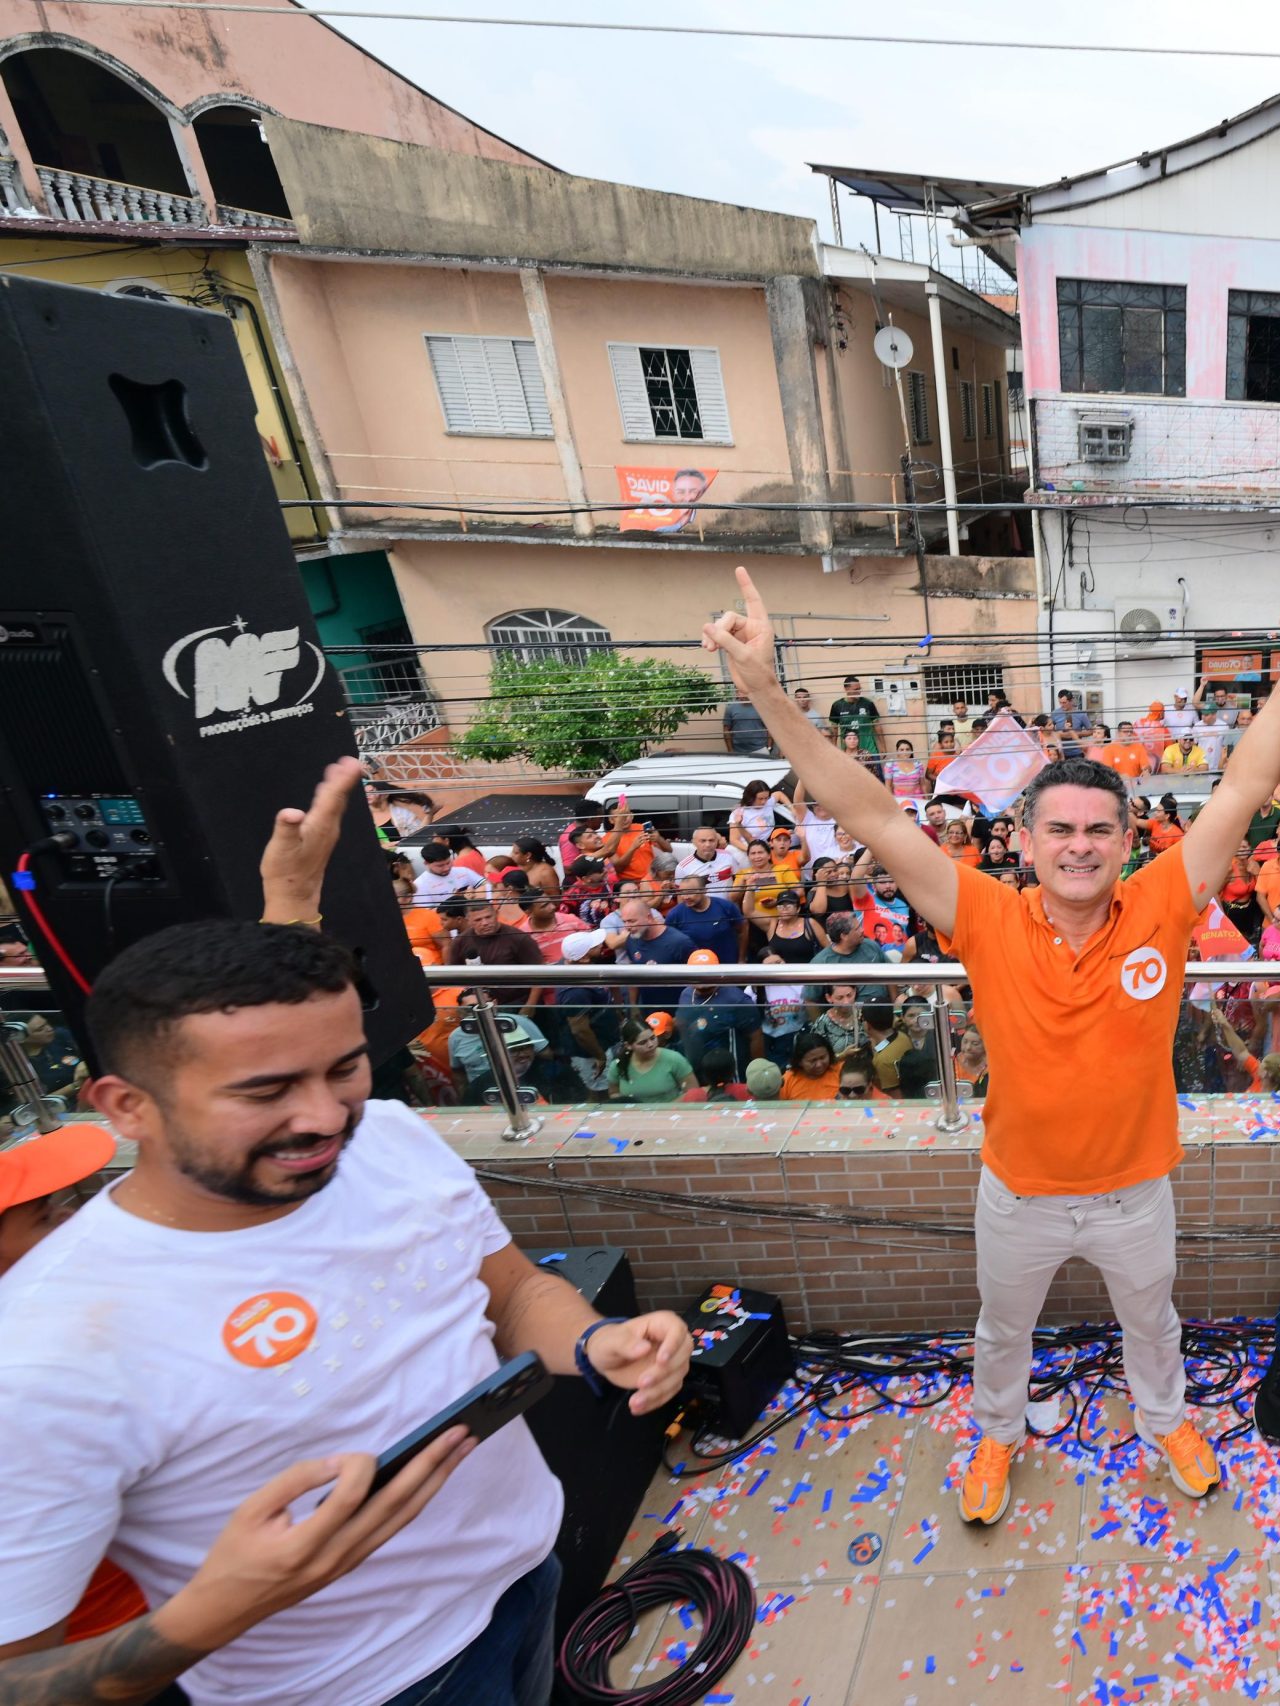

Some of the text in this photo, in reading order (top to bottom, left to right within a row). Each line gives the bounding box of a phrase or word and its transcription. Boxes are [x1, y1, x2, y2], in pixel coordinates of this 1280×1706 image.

[626, 476, 671, 493] DAVID
[630, 489, 674, 517] 70
[1201, 929, 1235, 941] RENATO
[1124, 957, 1163, 990] 70
[232, 1307, 307, 1360] 70
